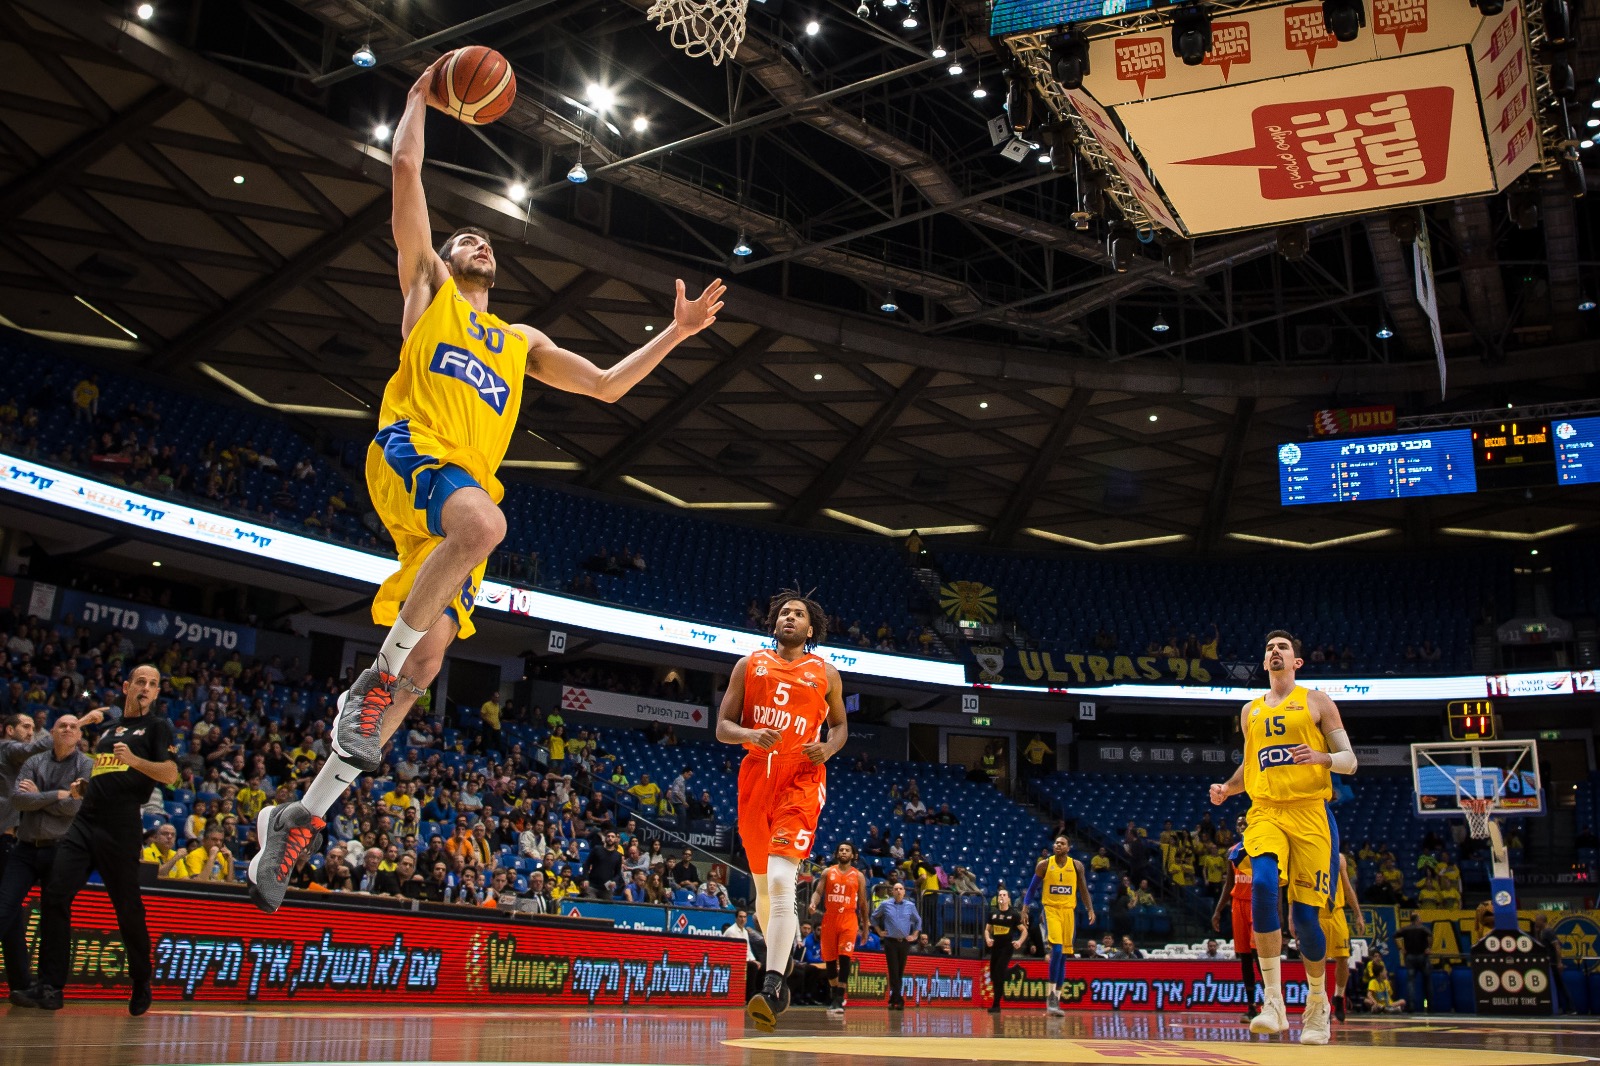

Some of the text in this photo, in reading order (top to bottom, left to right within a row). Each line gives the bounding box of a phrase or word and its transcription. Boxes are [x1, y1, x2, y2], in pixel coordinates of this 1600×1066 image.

[1286, 12, 1323, 28] עדני
[1379, 7, 1426, 26] הטלה
[1212, 26, 1248, 43] מעד
[1116, 42, 1163, 59] מעדני
[1120, 54, 1164, 73] הטלה
[1290, 108, 1368, 192] הטלה
[1354, 94, 1426, 186] מעדני
[466, 312, 504, 354] 50
[440, 350, 506, 408] FOX
[1368, 442, 1398, 454] פוקס
[1400, 439, 1432, 450] מכבי
[8, 466, 54, 490] קליל
[124, 499, 165, 522] קליל
[234, 528, 272, 548] קליל
[511, 588, 530, 612] 10
[83, 602, 238, 650] טריפל מדיה
[690, 628, 718, 644] קליל
[550, 634, 564, 649] 10
[830, 652, 858, 666] קליל
[1018, 650, 1212, 683] ULTRAS 96
[1344, 684, 1370, 694] קליל
[1487, 677, 1507, 694] 11
[1572, 672, 1595, 690] 12
[773, 682, 792, 706] 5
[964, 698, 978, 709] 10
[637, 703, 690, 720] בנק הפועלים
[1082, 706, 1093, 716] 11
[794, 715, 807, 736] חי
[1264, 716, 1286, 738] 15
[1260, 748, 1294, 768] FOX
[794, 829, 812, 850] 5
[832, 883, 846, 894] 31
[1314, 870, 1328, 894] 15
[156, 937, 243, 994] תיקח?
[250, 943, 290, 995] איך
[374, 932, 406, 986] לא
[406, 952, 442, 988] אם
[490, 938, 568, 988] Winner
[573, 960, 621, 1003] תיקח?
[624, 962, 647, 1004] איך
[692, 953, 710, 993] לא
[710, 965, 730, 993] אם
[848, 964, 888, 995] Winner
[1003, 970, 1086, 1000] Winer
[1091, 980, 1148, 1008] תיקח?
[1153, 981, 1183, 1008] איך
[1492, 997, 1519, 1006] QUALITY
